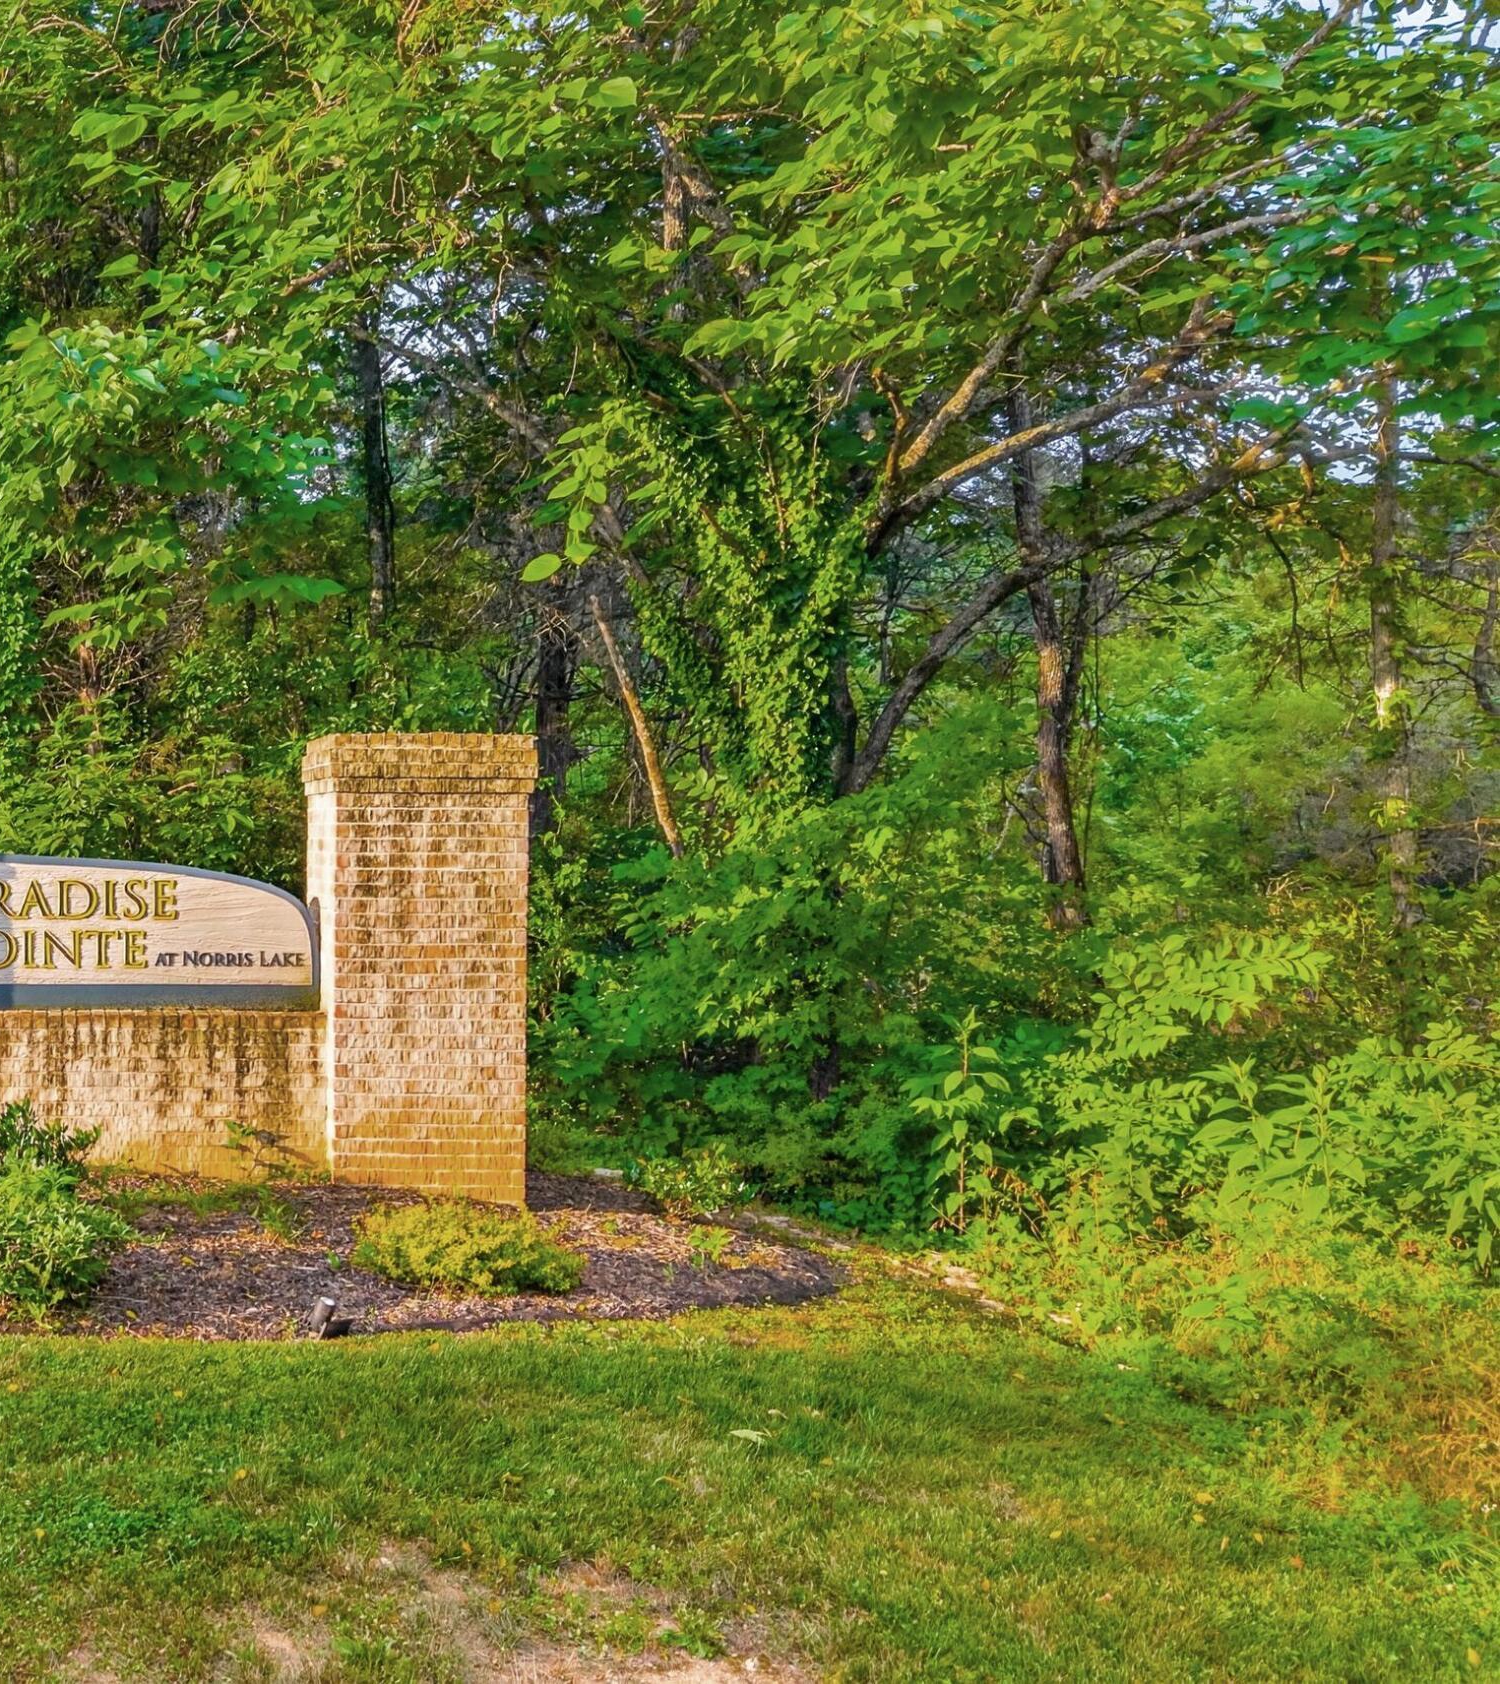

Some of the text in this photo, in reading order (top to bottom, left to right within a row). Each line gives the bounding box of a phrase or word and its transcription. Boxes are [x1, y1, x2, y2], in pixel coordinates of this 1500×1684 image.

[155, 949, 305, 968] AT NORRIS LAKE
